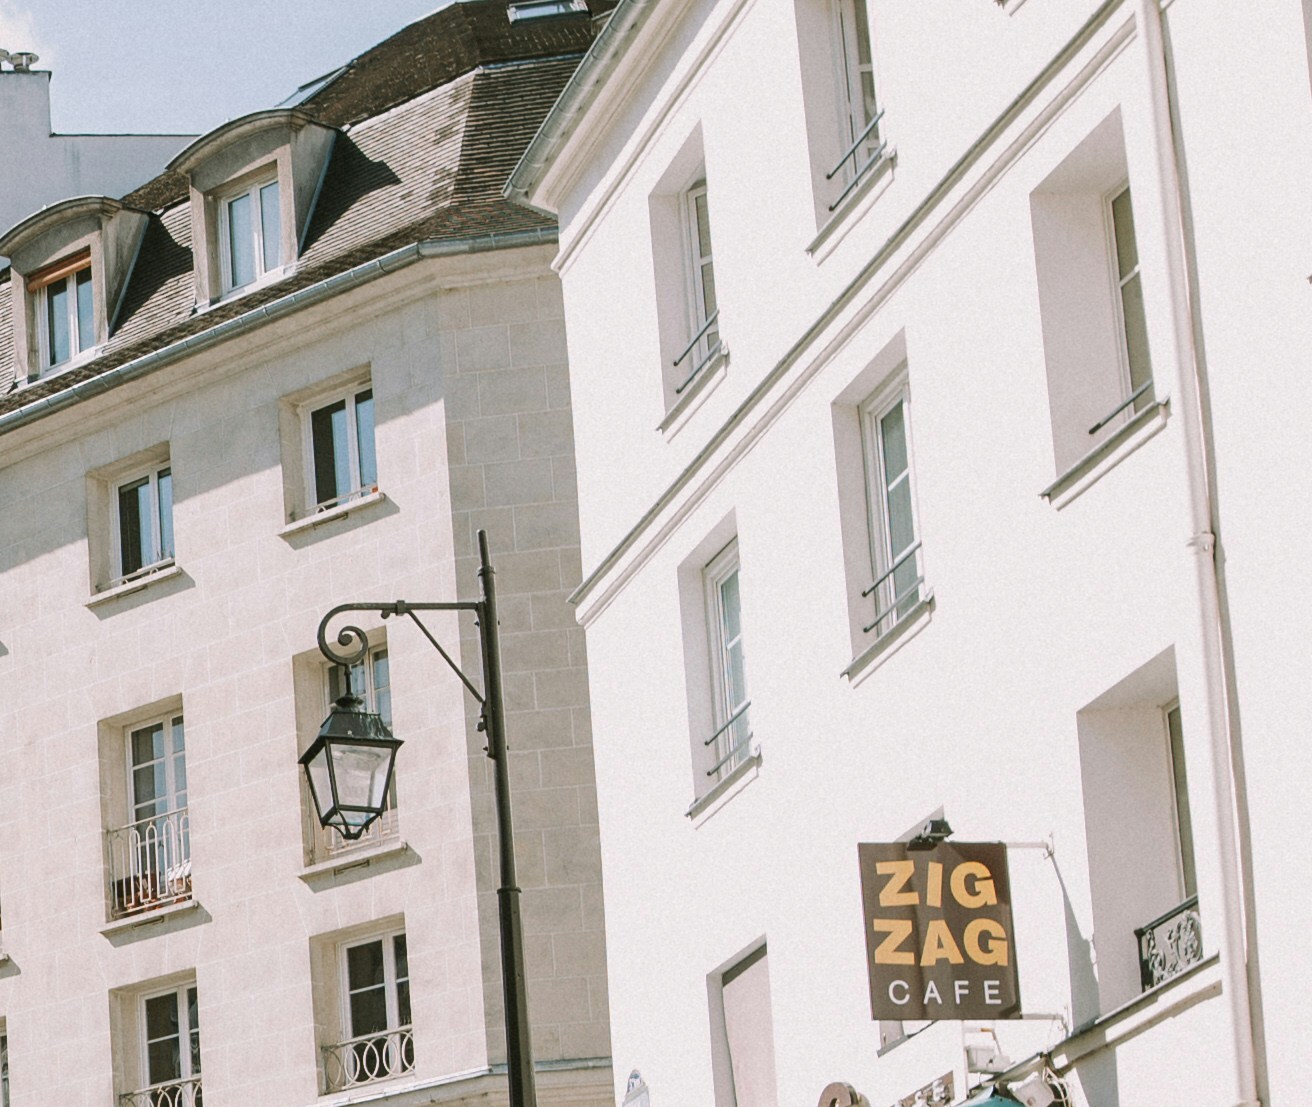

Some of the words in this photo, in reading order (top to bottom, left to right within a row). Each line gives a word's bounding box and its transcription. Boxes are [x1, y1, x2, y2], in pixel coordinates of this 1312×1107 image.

[875, 860, 998, 909] ZIG
[872, 917, 1009, 968] ZAG
[887, 979, 1003, 1006] CAFE
